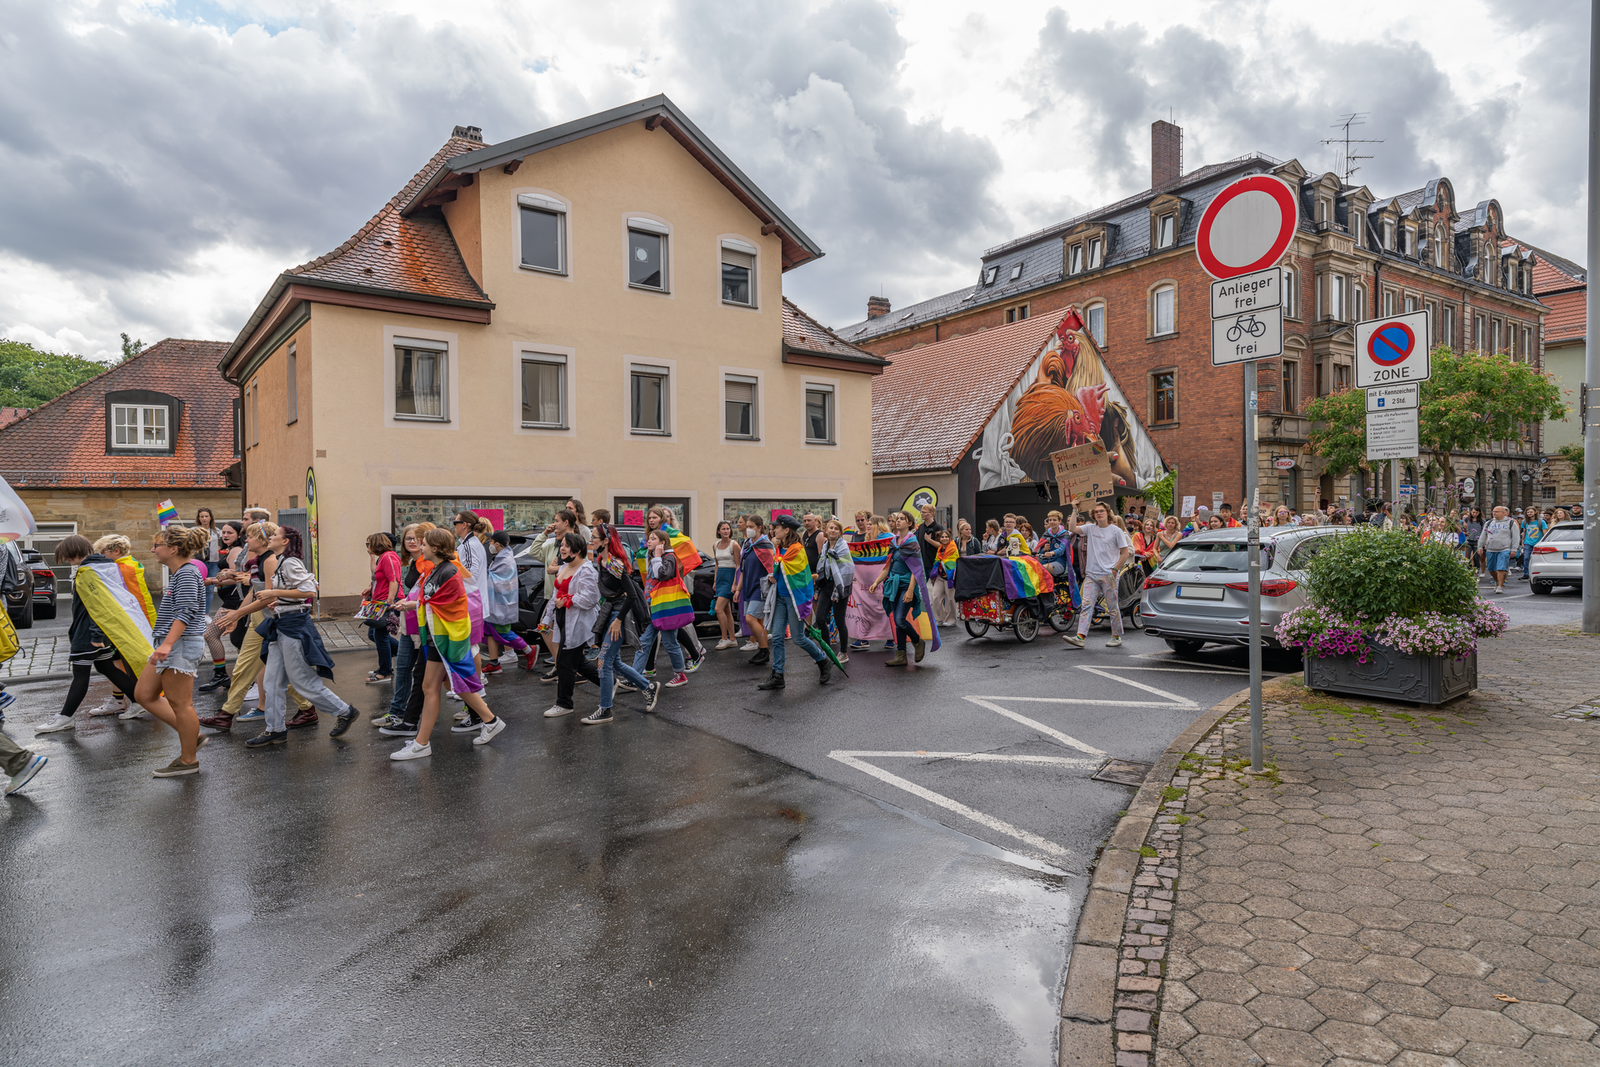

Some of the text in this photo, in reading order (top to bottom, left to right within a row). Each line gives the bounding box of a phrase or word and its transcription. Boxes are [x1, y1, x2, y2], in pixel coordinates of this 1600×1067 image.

[1219, 277, 1273, 298] Anlieger
[1235, 294, 1256, 308] frei
[1236, 341, 1257, 355] frei
[1374, 366, 1409, 381] ZONE
[1379, 388, 1415, 396] E-Kennzeichen
[1054, 451, 1077, 463] Schluss
[1063, 484, 1112, 503] Homo-Promo
